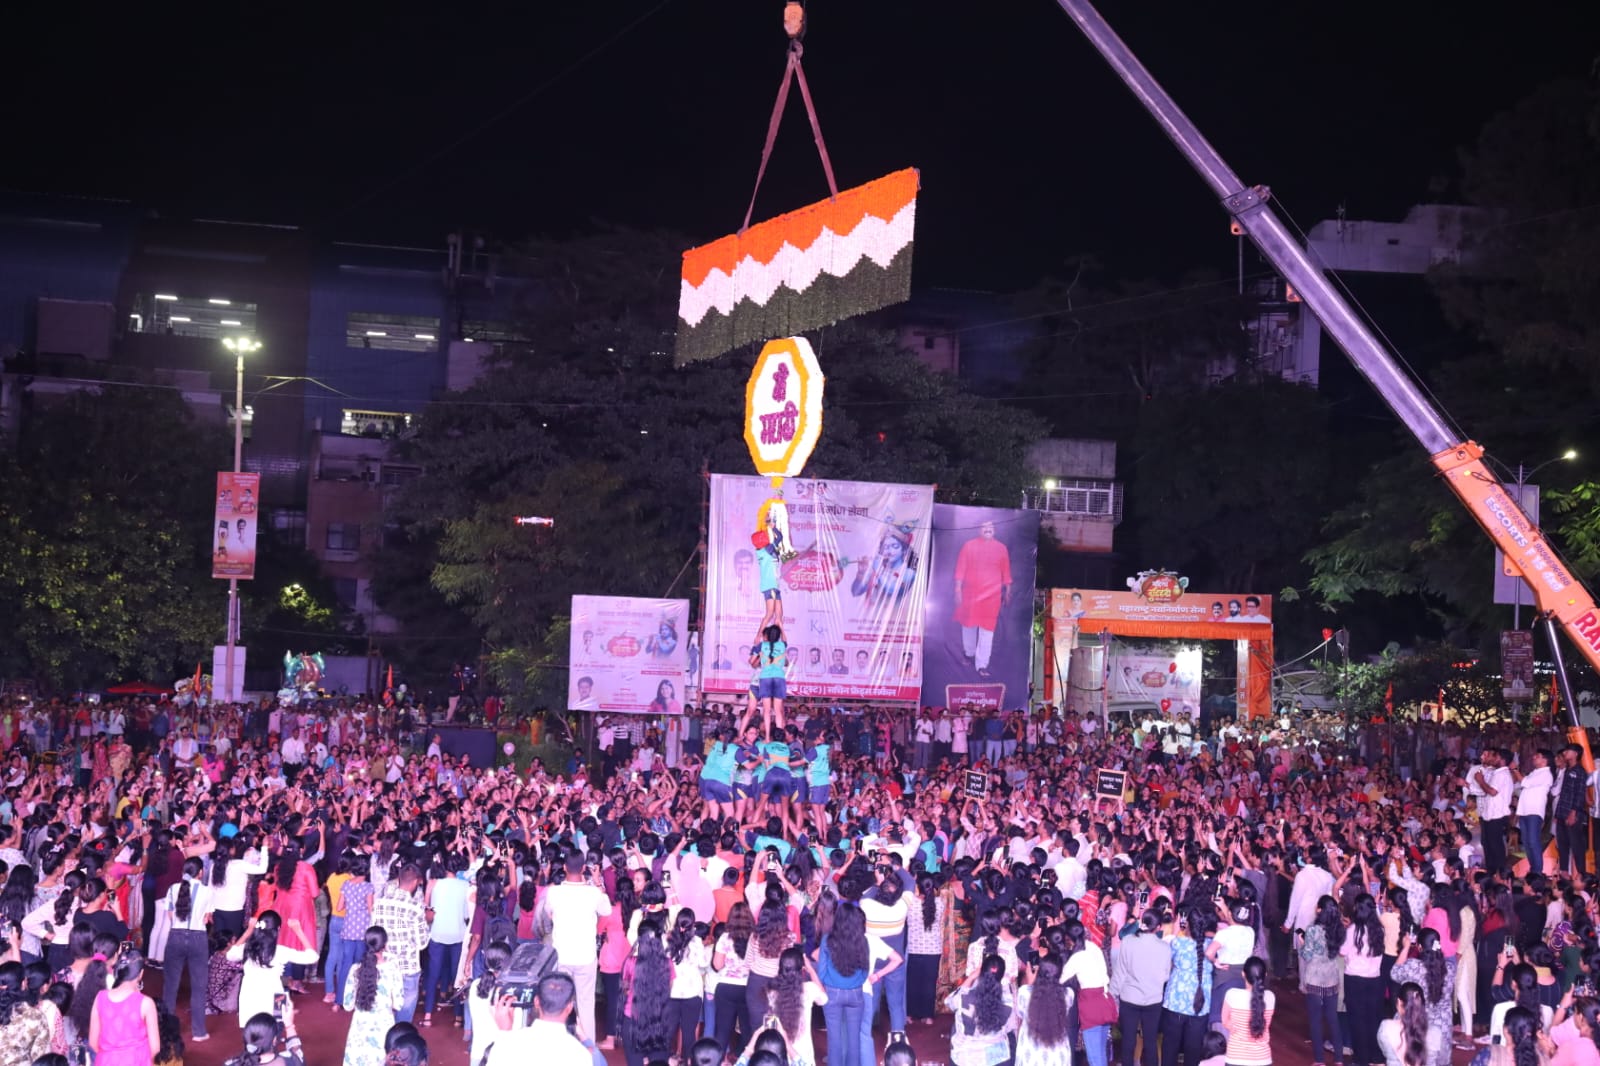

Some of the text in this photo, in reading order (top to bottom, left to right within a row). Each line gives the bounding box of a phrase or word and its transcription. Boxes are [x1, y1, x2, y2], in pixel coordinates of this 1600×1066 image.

[759, 400, 799, 445] मराठी
[848, 504, 869, 517] सेना
[1485, 496, 1529, 548] ESCORTS
[1190, 604, 1207, 614] सेना
